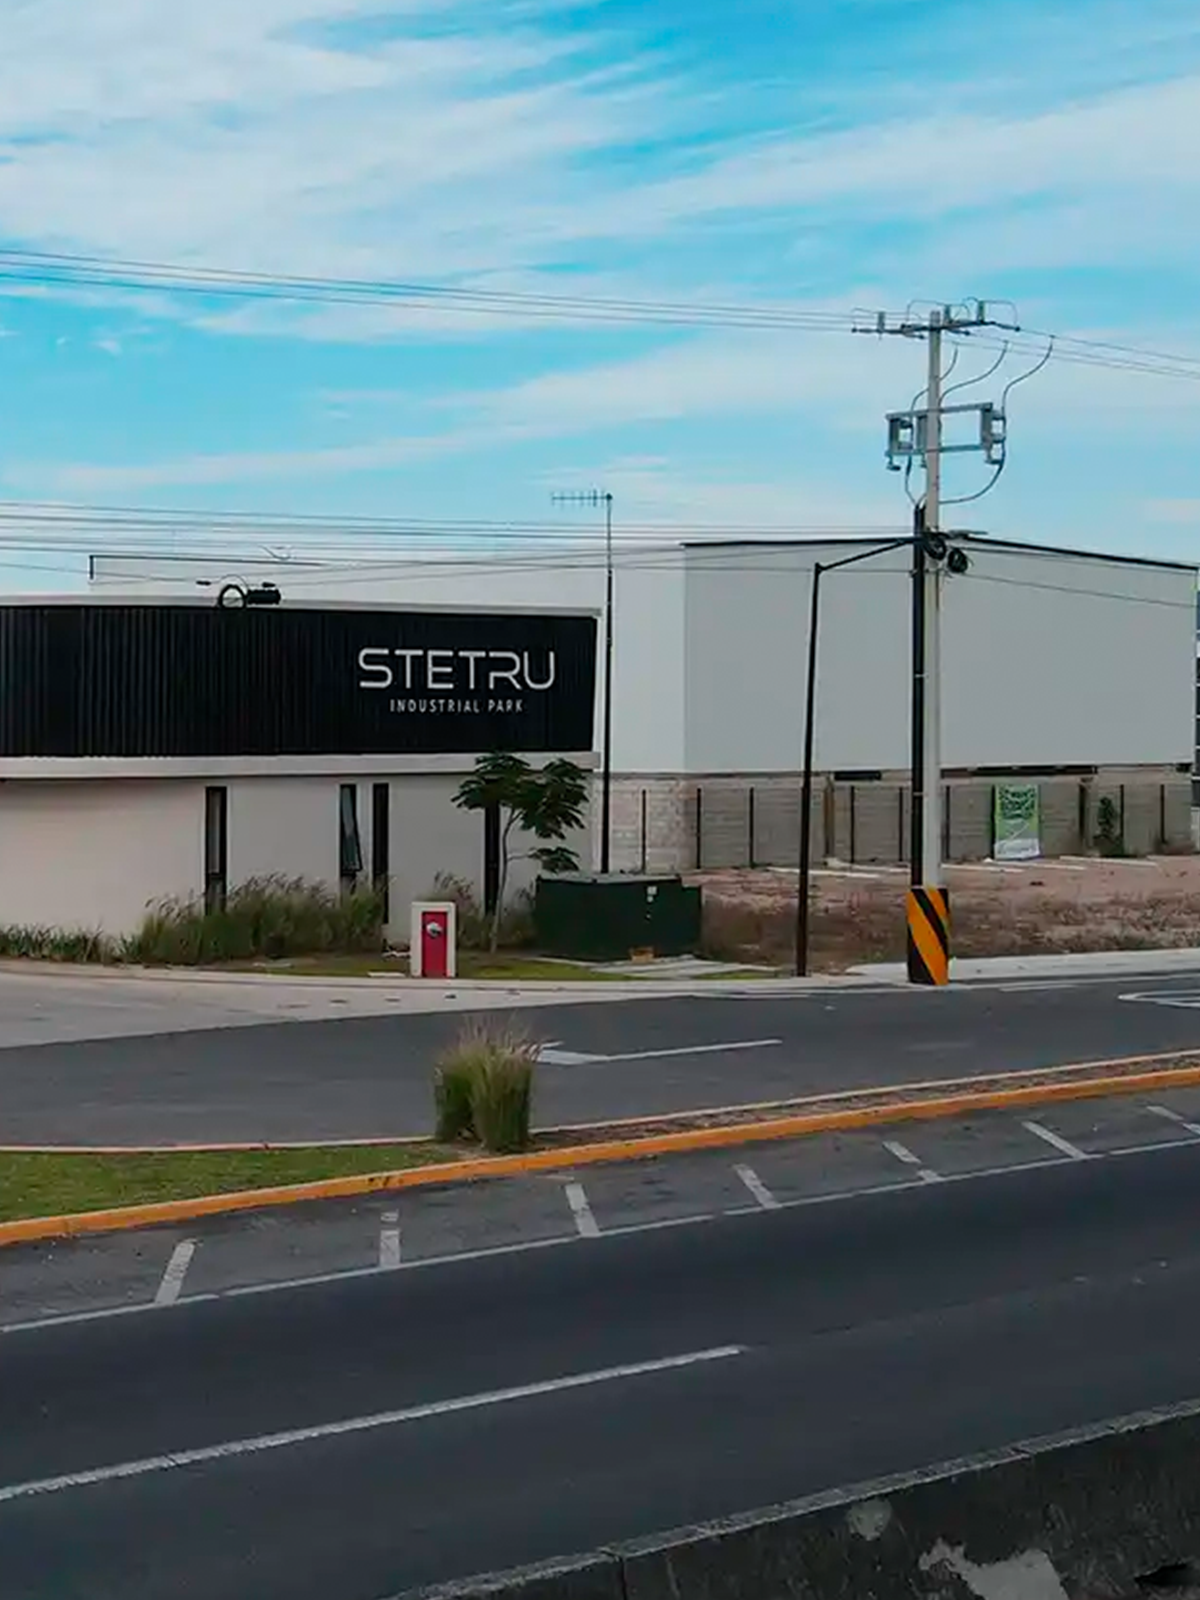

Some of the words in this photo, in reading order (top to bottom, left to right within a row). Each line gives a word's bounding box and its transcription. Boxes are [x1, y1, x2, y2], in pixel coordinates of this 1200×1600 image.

[358, 647, 555, 690] STETRU
[389, 699, 480, 713] INDUSTRIAL
[488, 699, 524, 713] PARK
